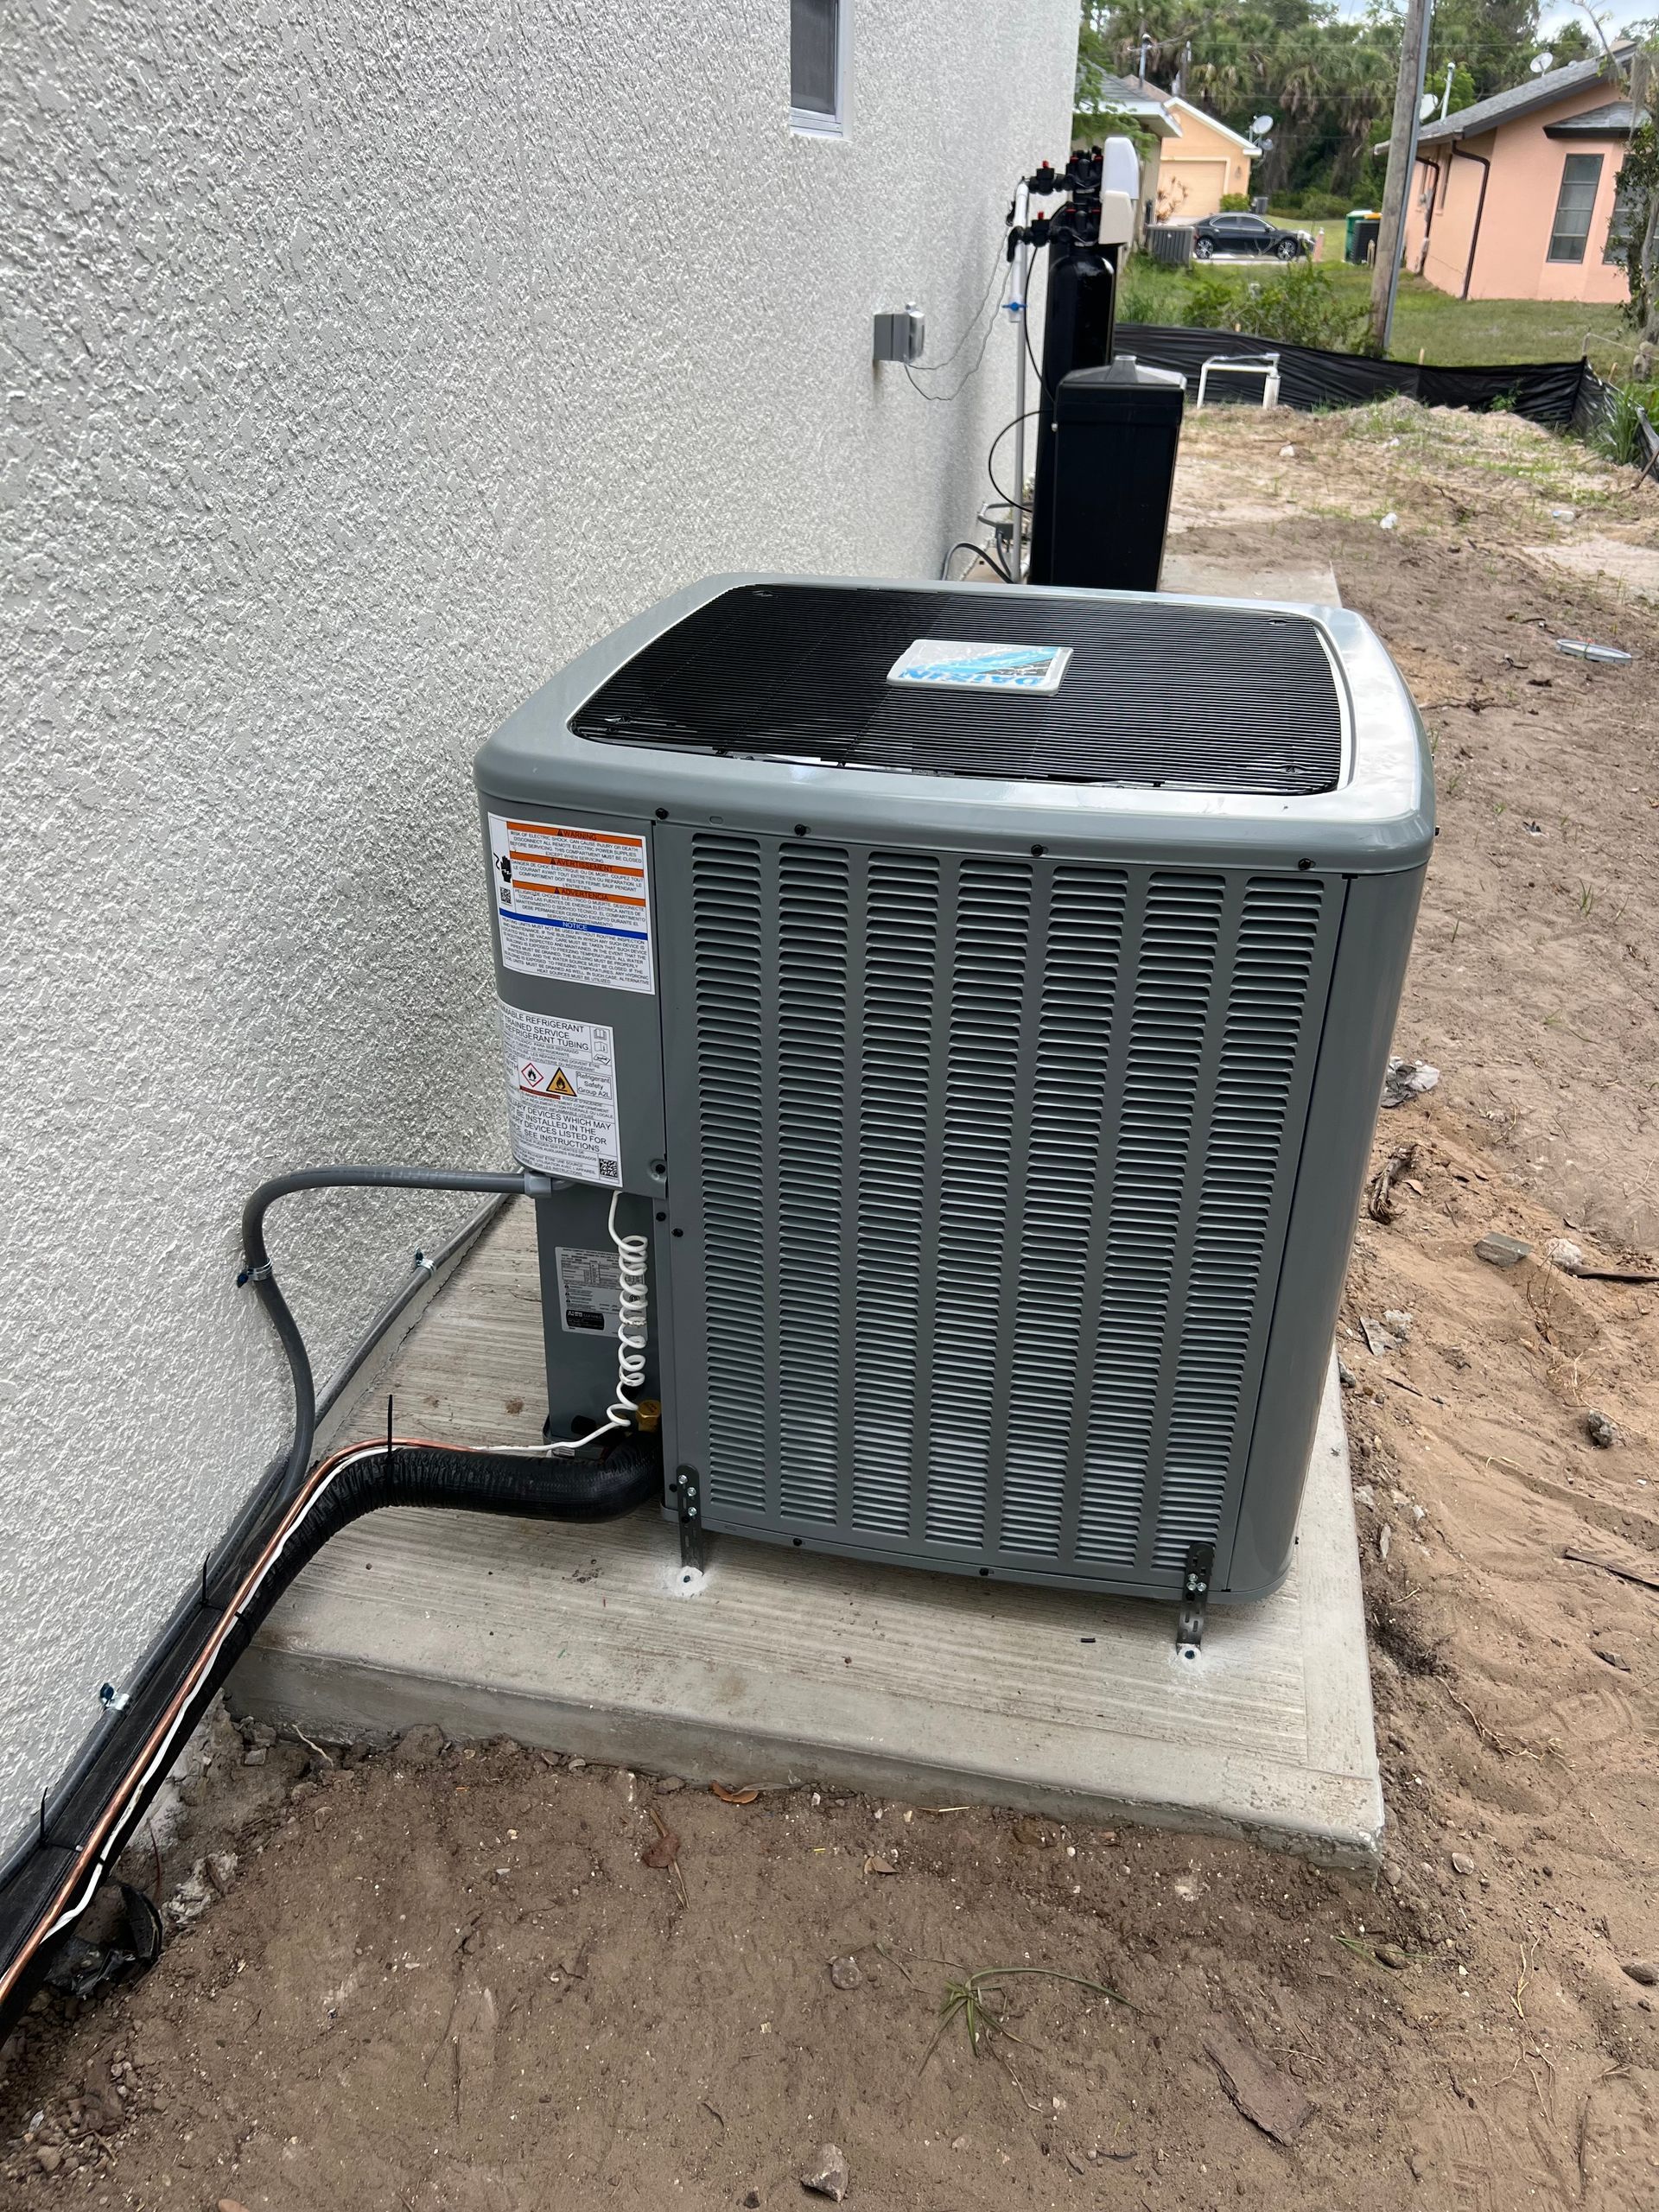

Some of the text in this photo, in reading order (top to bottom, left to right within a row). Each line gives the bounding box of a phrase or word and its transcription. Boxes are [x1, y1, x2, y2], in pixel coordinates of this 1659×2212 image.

[563, 830, 596, 840] WARNING
[565, 849, 601, 857] COMPARTMENT
[556, 859, 612, 872] AVERTISSEMENT
[562, 888, 608, 900] ADVERTENCIA
[563, 921, 588, 930] NOTICE
[505, 1015, 531, 1032] TRAINED
[534, 1027, 569, 1039] SERVICE
[526, 1015, 584, 1033] REFRIGERANT
[505, 1023, 554, 1044] REFRIGERANT
[557, 1039, 588, 1051] TUBING
[579, 1087, 596, 1096] Group
[584, 1081, 603, 1090] Safety
[526, 1113, 567, 1129] INSTALLED
[581, 1126, 596, 1135] THE
[527, 1106, 562, 1121] DEVICES
[563, 1115, 591, 1127] WHICH
[594, 1121, 611, 1131] MAY
[524, 1119, 556, 1135] DEVICES
[559, 1129, 587, 1141] LISTED
[589, 1135, 607, 1146] FOR
[524, 1128, 538, 1140] SEE
[540, 1134, 600, 1153] INSTRUCTIONS
